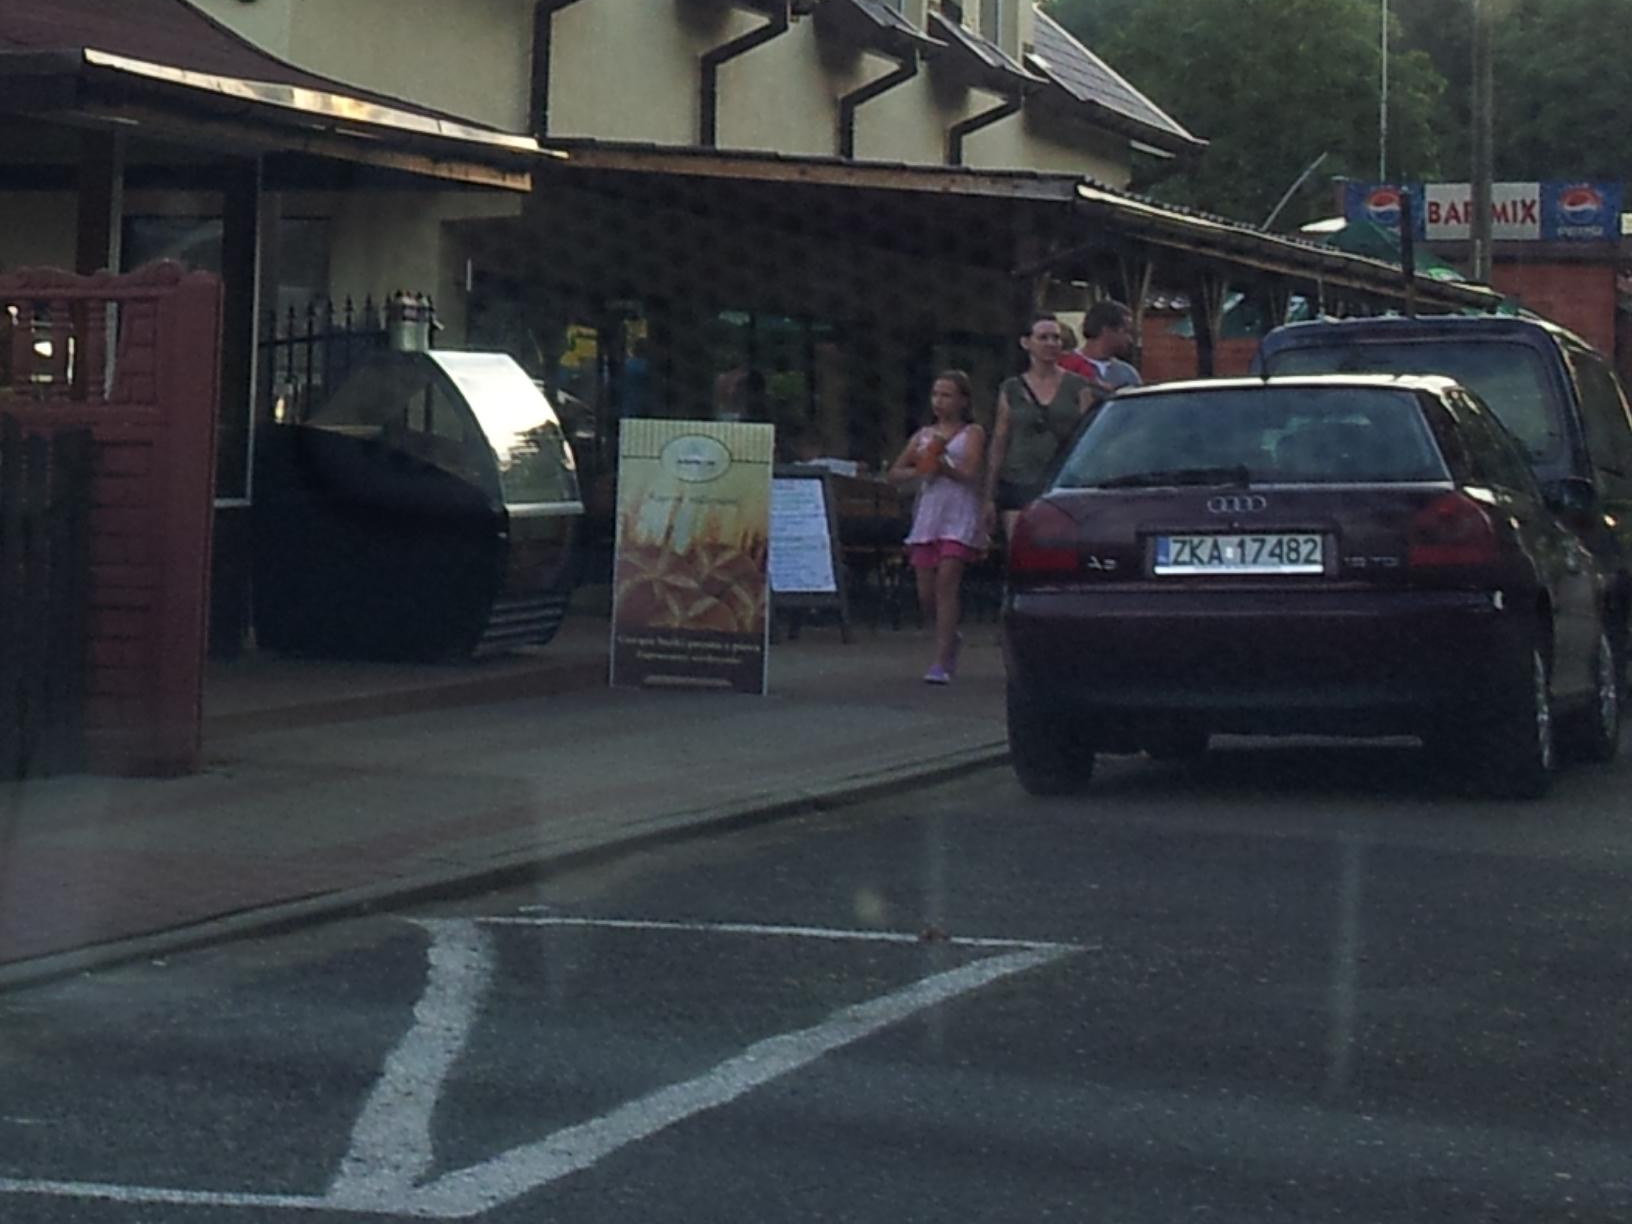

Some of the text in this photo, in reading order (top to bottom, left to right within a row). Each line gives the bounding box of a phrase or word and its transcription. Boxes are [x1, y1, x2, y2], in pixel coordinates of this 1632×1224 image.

[1490, 199, 1537, 224] MIX
[1171, 538, 1224, 565] ZKA
[1236, 537, 1323, 565] 17482
